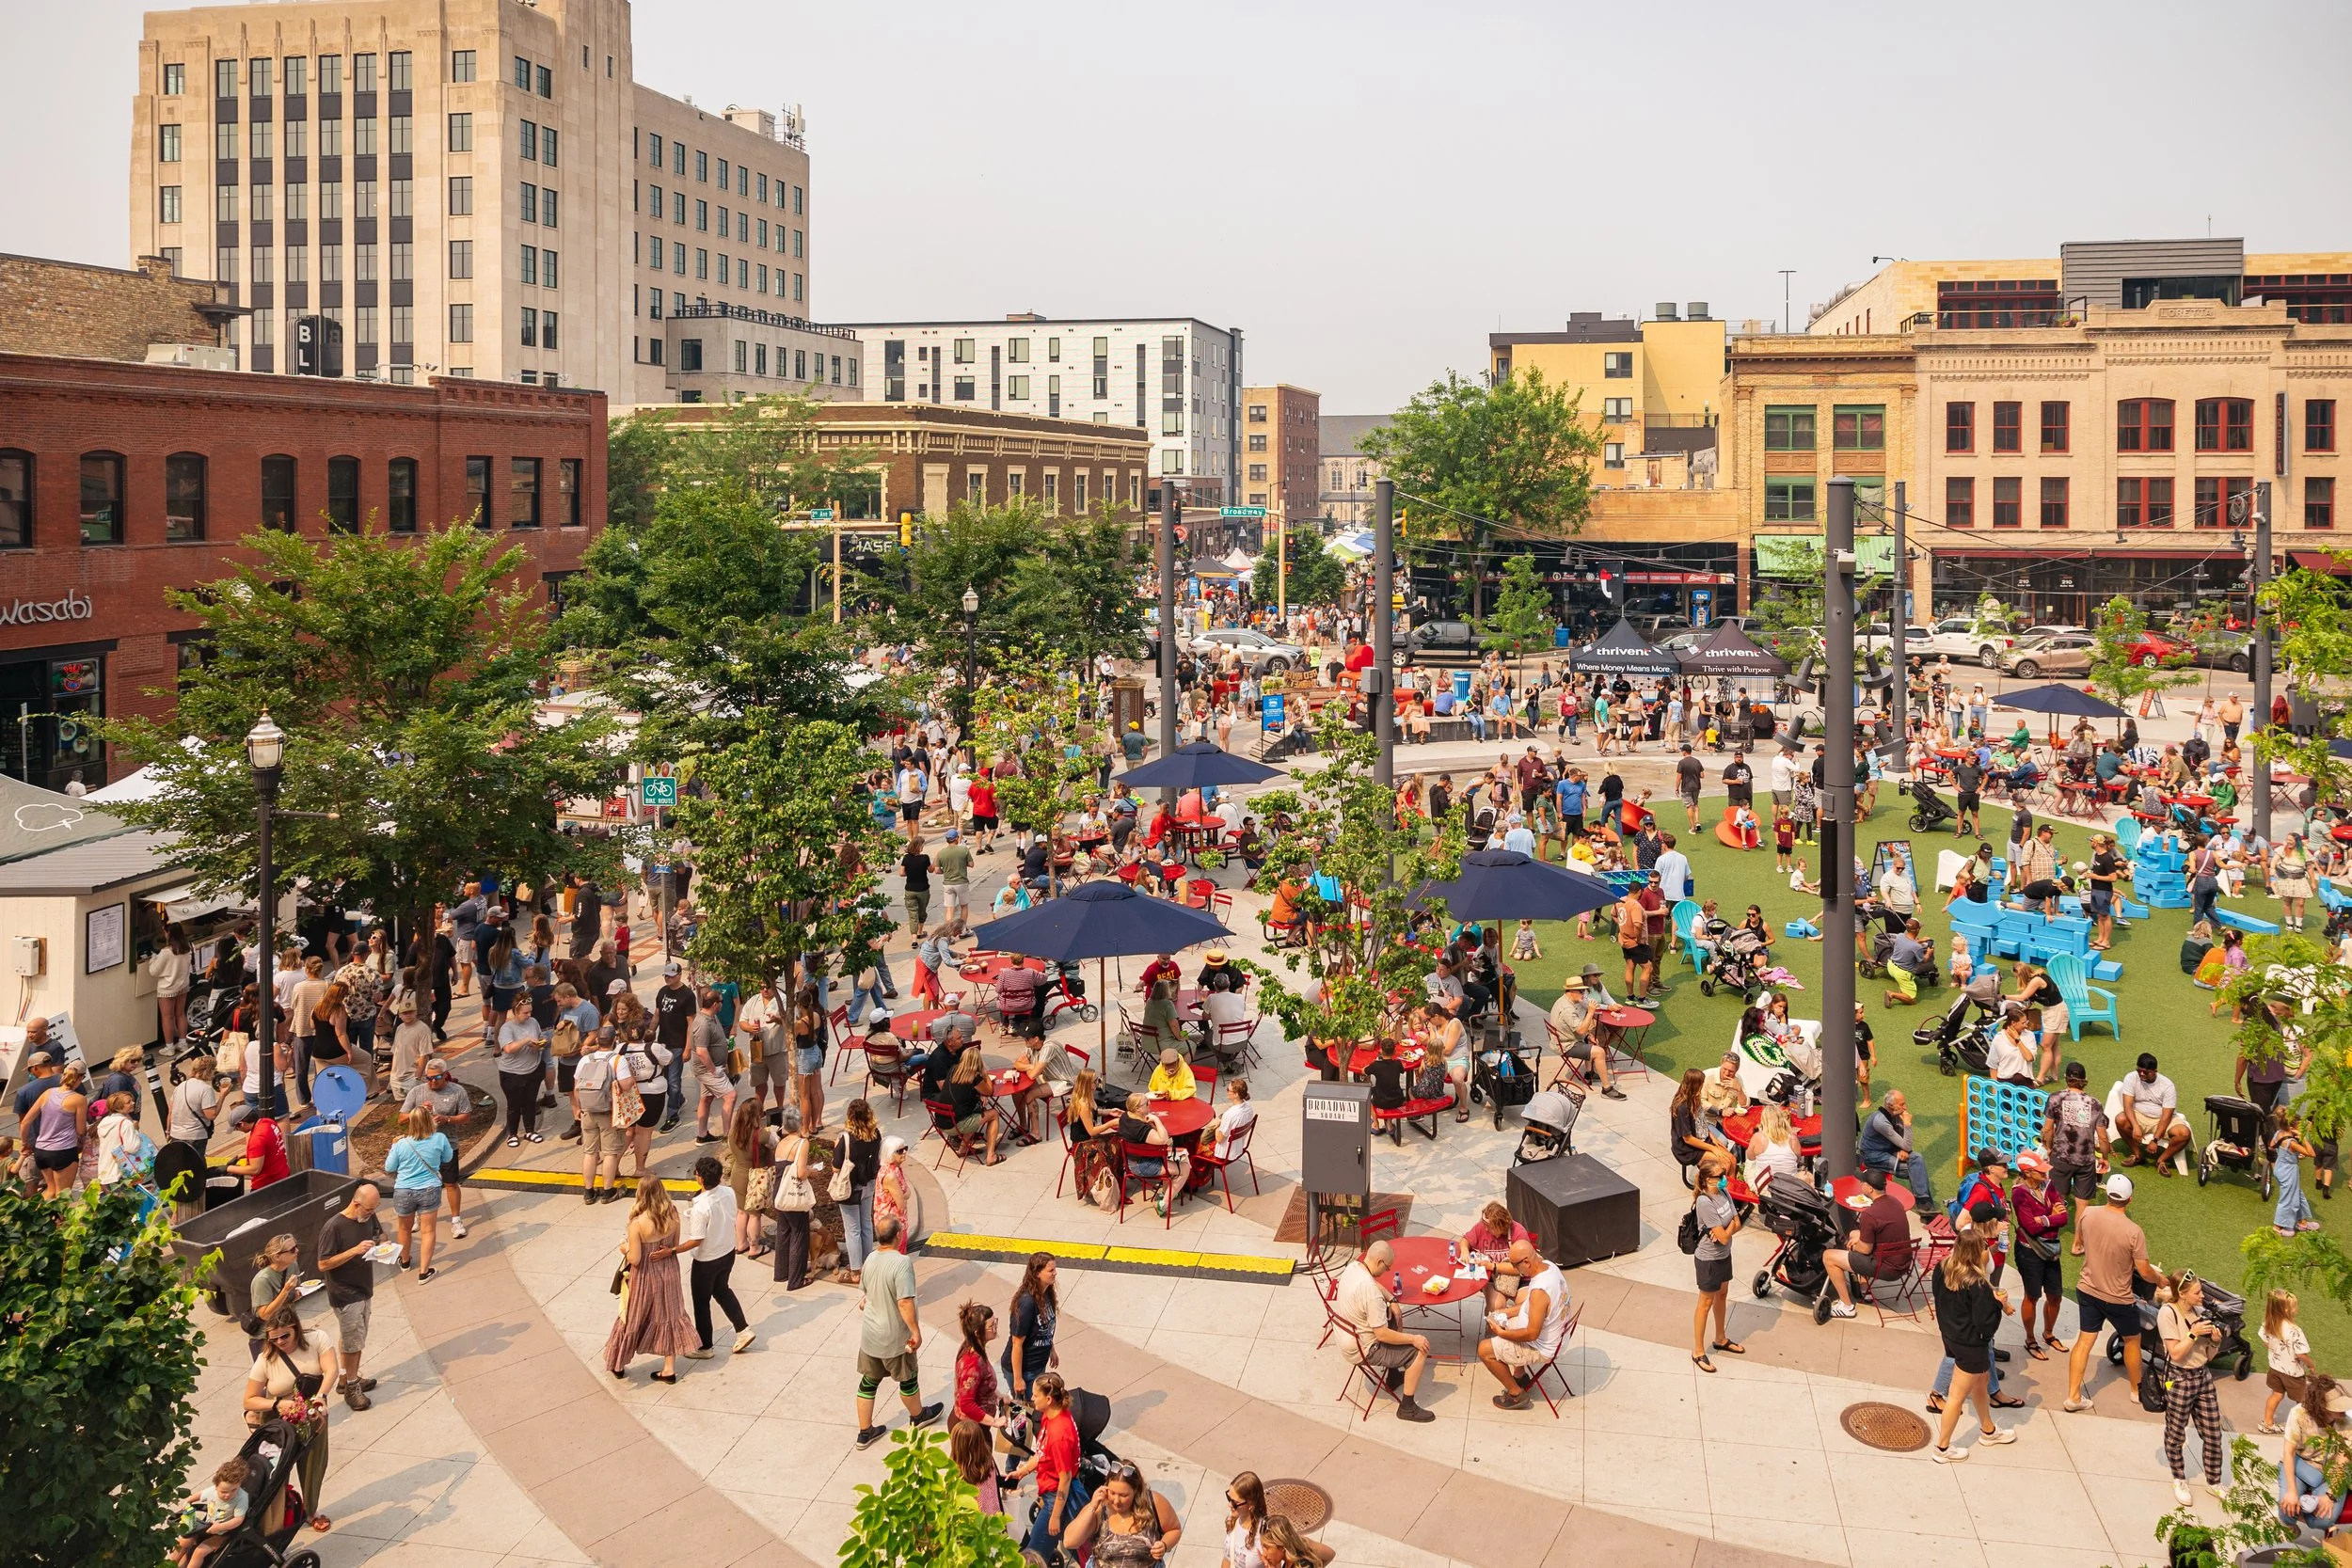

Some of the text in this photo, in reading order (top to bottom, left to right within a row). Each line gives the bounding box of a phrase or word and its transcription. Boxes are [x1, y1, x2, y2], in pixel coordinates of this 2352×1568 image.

[2160, 309, 2213, 318] LORETTA
[1223, 508, 1263, 516] Broadway
[1597, 646, 1652, 657] thrivent
[1705, 647, 1761, 657] thrivent
[1576, 663, 1674, 673] Where Money Means More.
[1725, 665, 1741, 673] with
[1743, 666, 1771, 674] Purpose
[1308, 1100, 1358, 1113] BROADWAY
